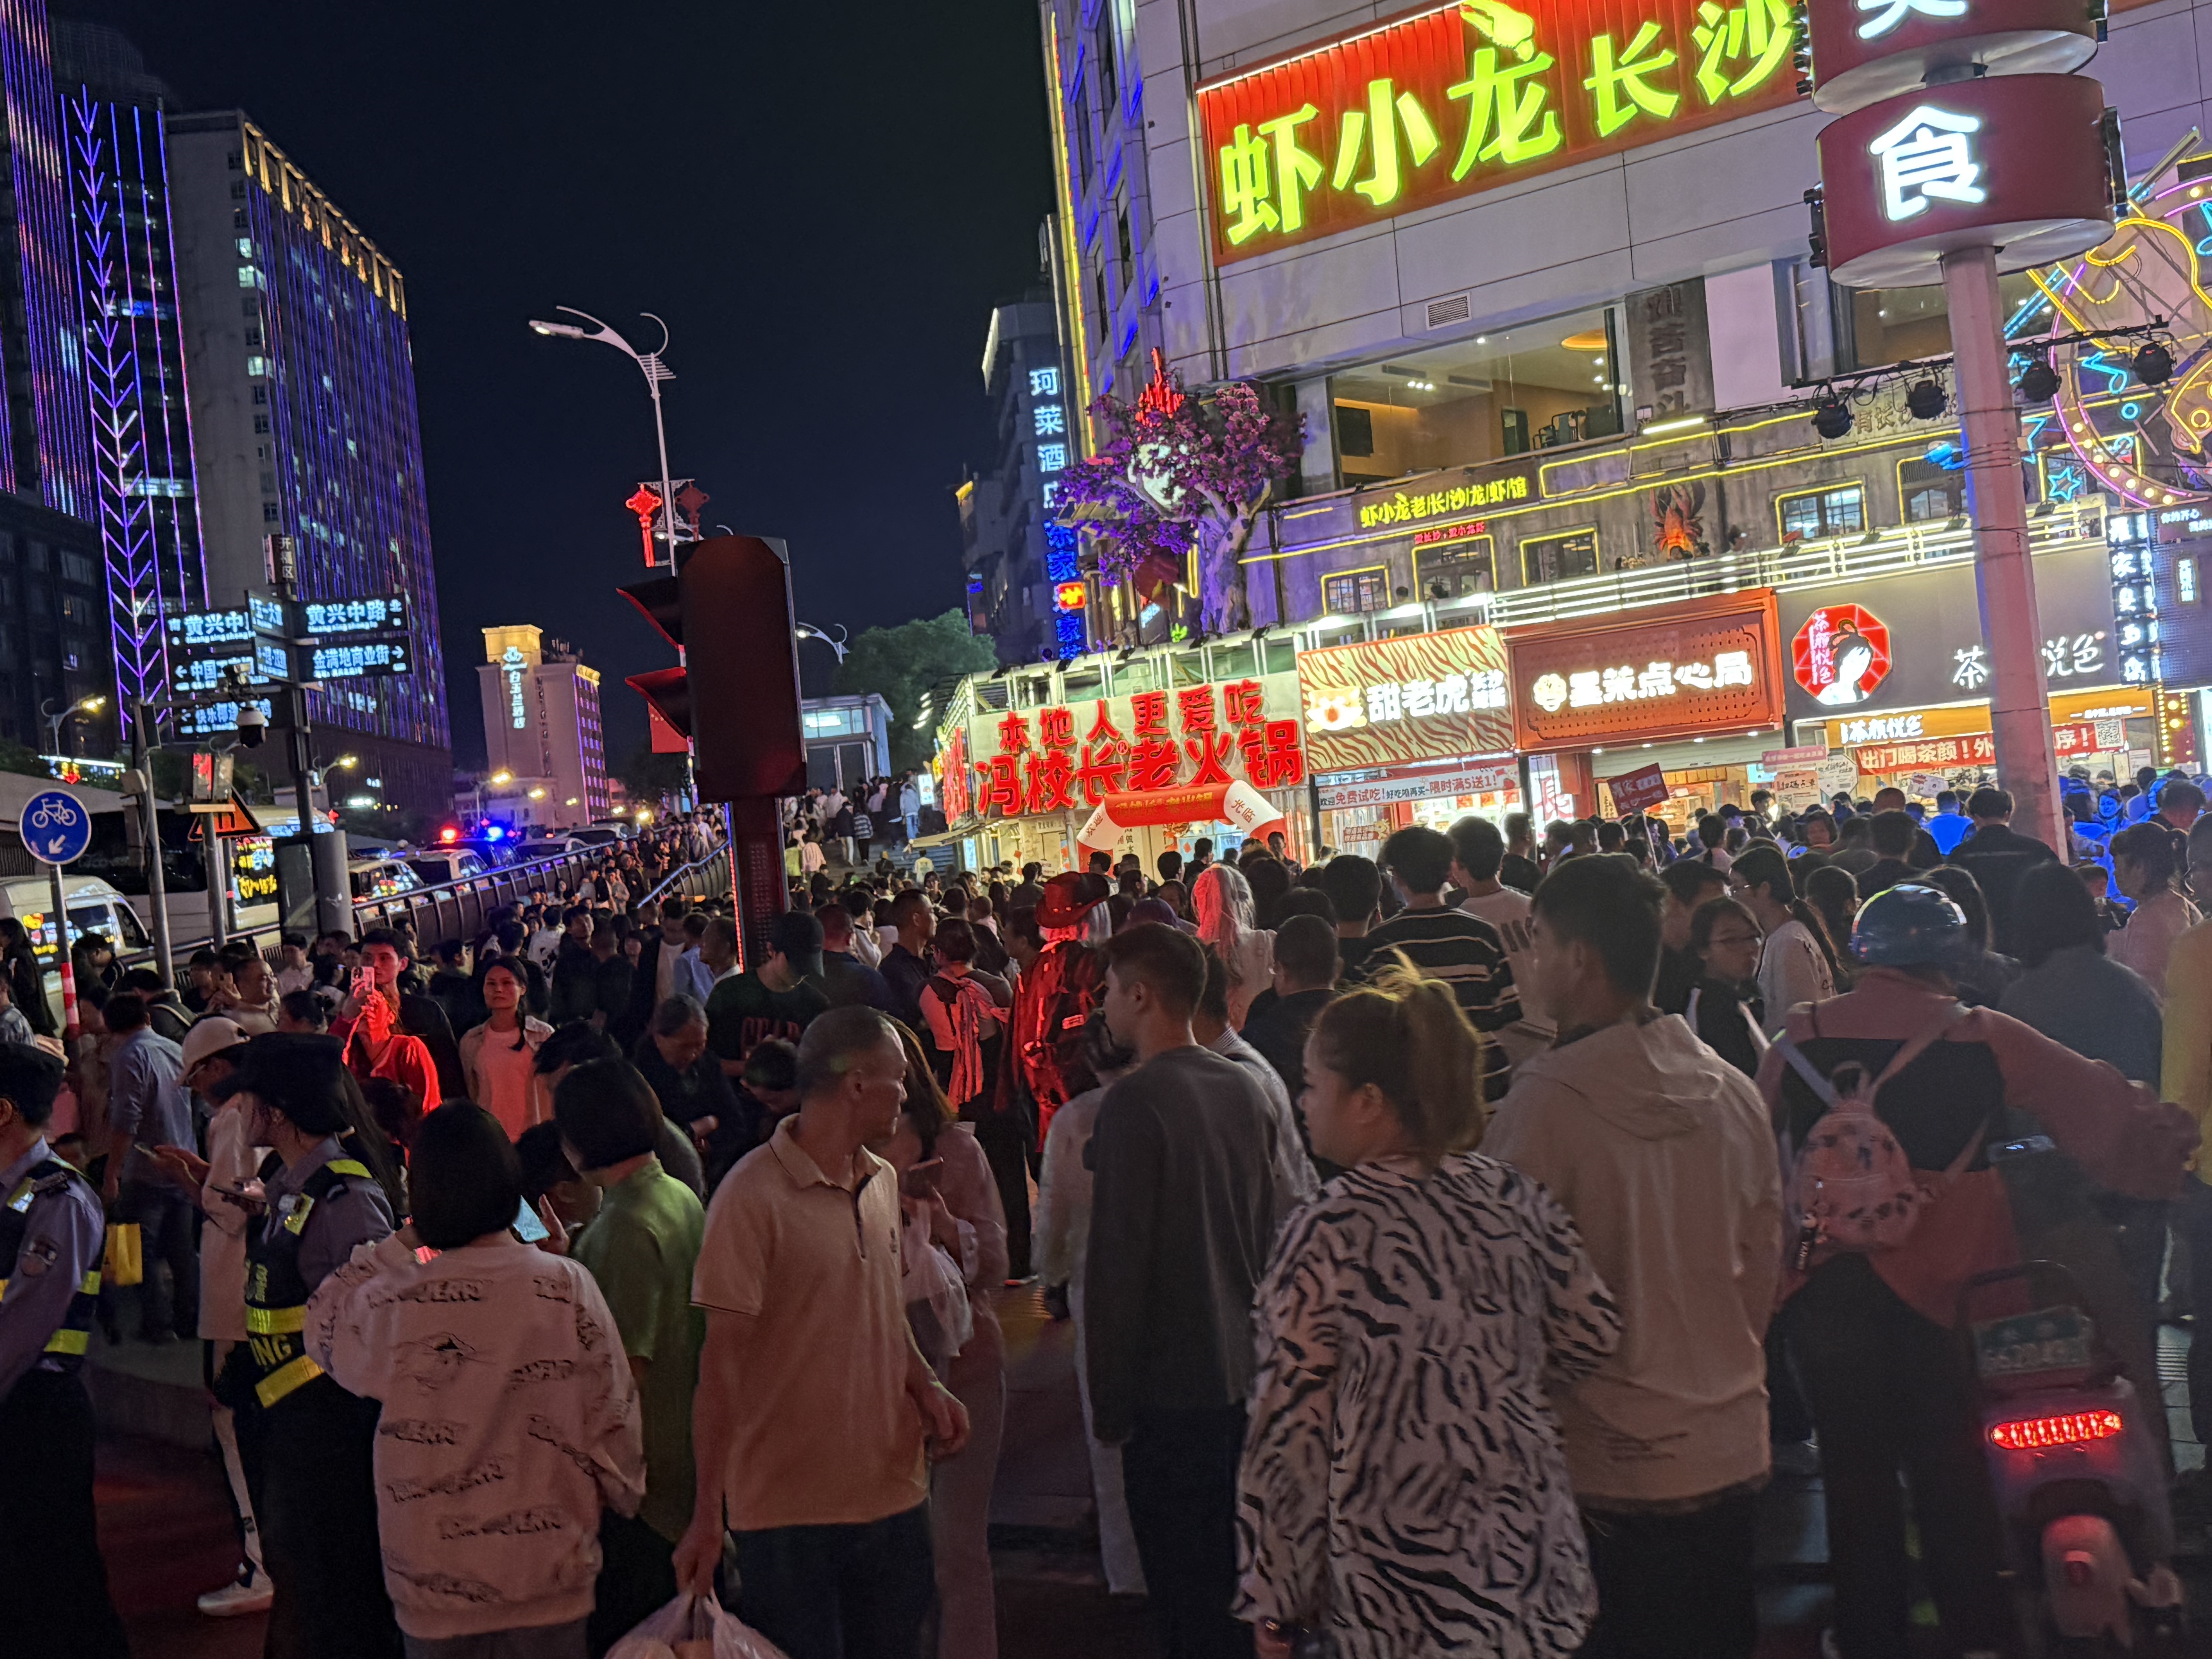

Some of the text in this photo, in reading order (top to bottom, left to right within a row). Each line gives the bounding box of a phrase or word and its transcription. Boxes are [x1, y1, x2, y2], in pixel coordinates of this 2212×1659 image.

[1869, 105, 1987, 222] 食
[184, 611, 249, 636] 黄兴中
[306, 599, 386, 625] 黄兴中路
[313, 644, 390, 669] 金满地商业街
[998, 678, 1266, 754] 本地人更爱吃
[1231, 798, 1257, 824] 光临
